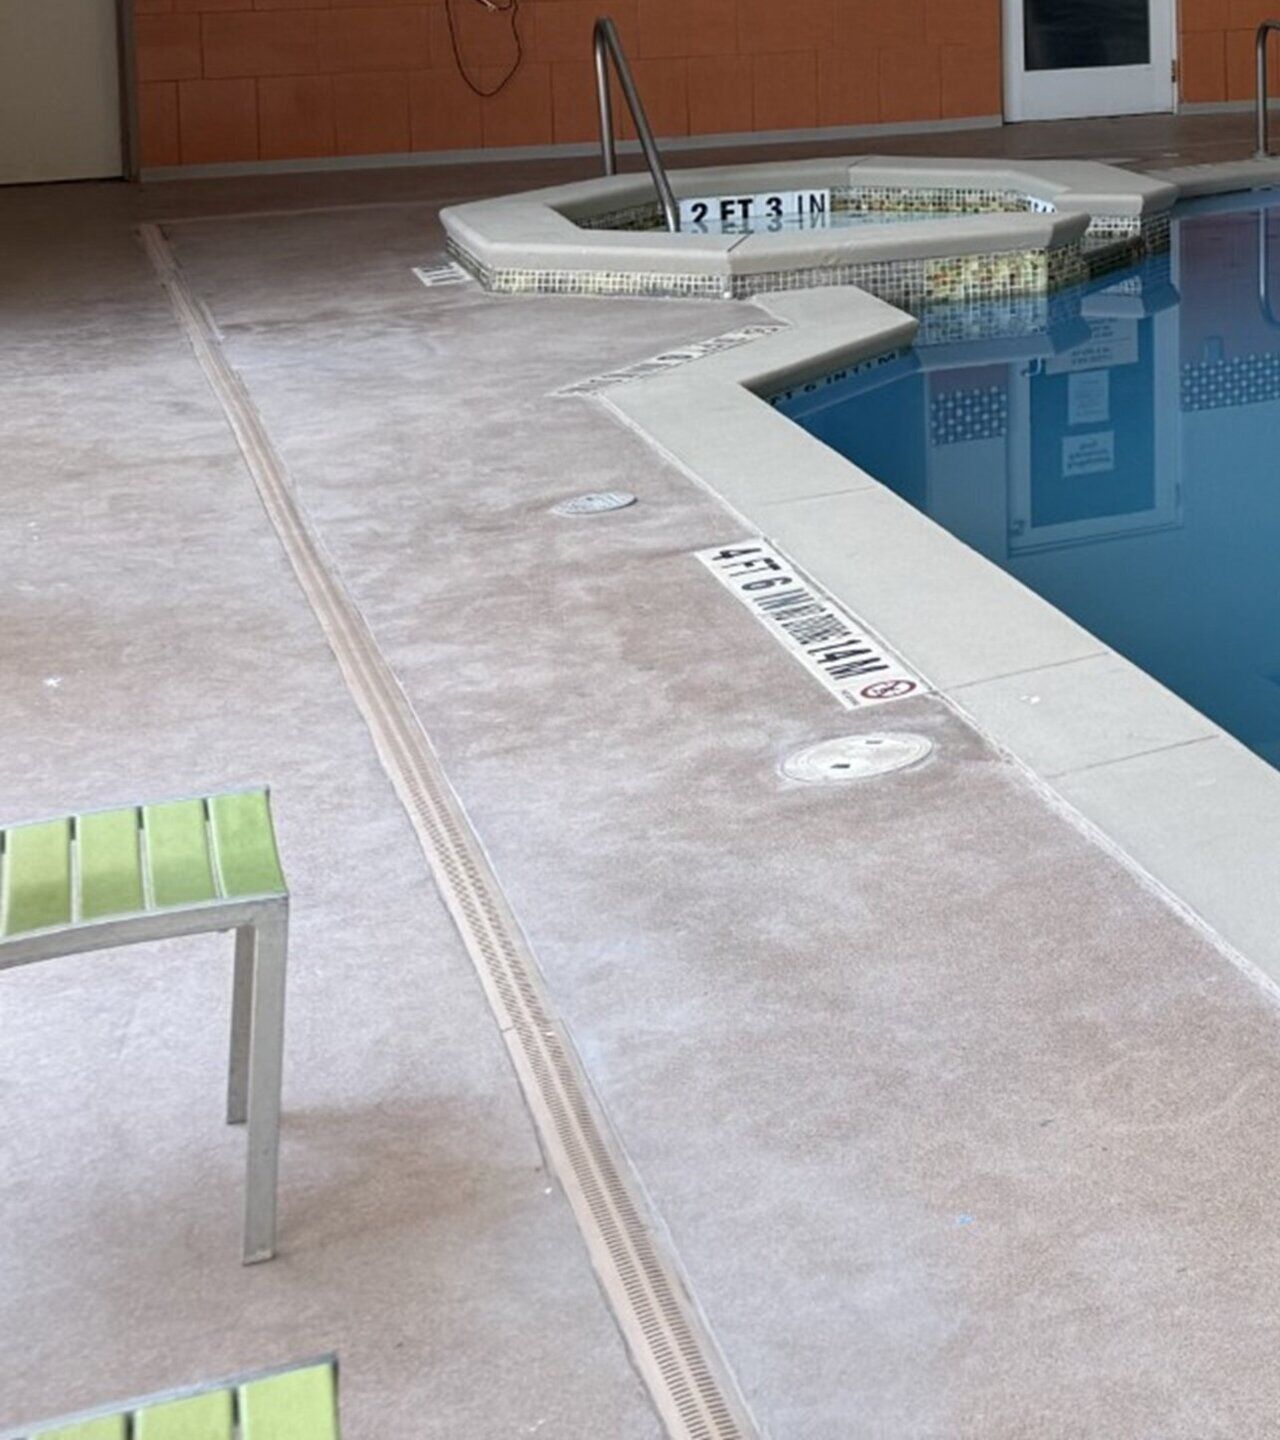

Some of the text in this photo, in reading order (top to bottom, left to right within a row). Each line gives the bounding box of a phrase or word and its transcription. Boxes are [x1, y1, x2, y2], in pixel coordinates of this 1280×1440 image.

[690, 193, 826, 223] 2 FT 3 IN
[712, 548, 762, 561] 4
[720, 558, 781, 577] FT
[741, 577, 792, 591] 6
[752, 588, 814, 611] IN
